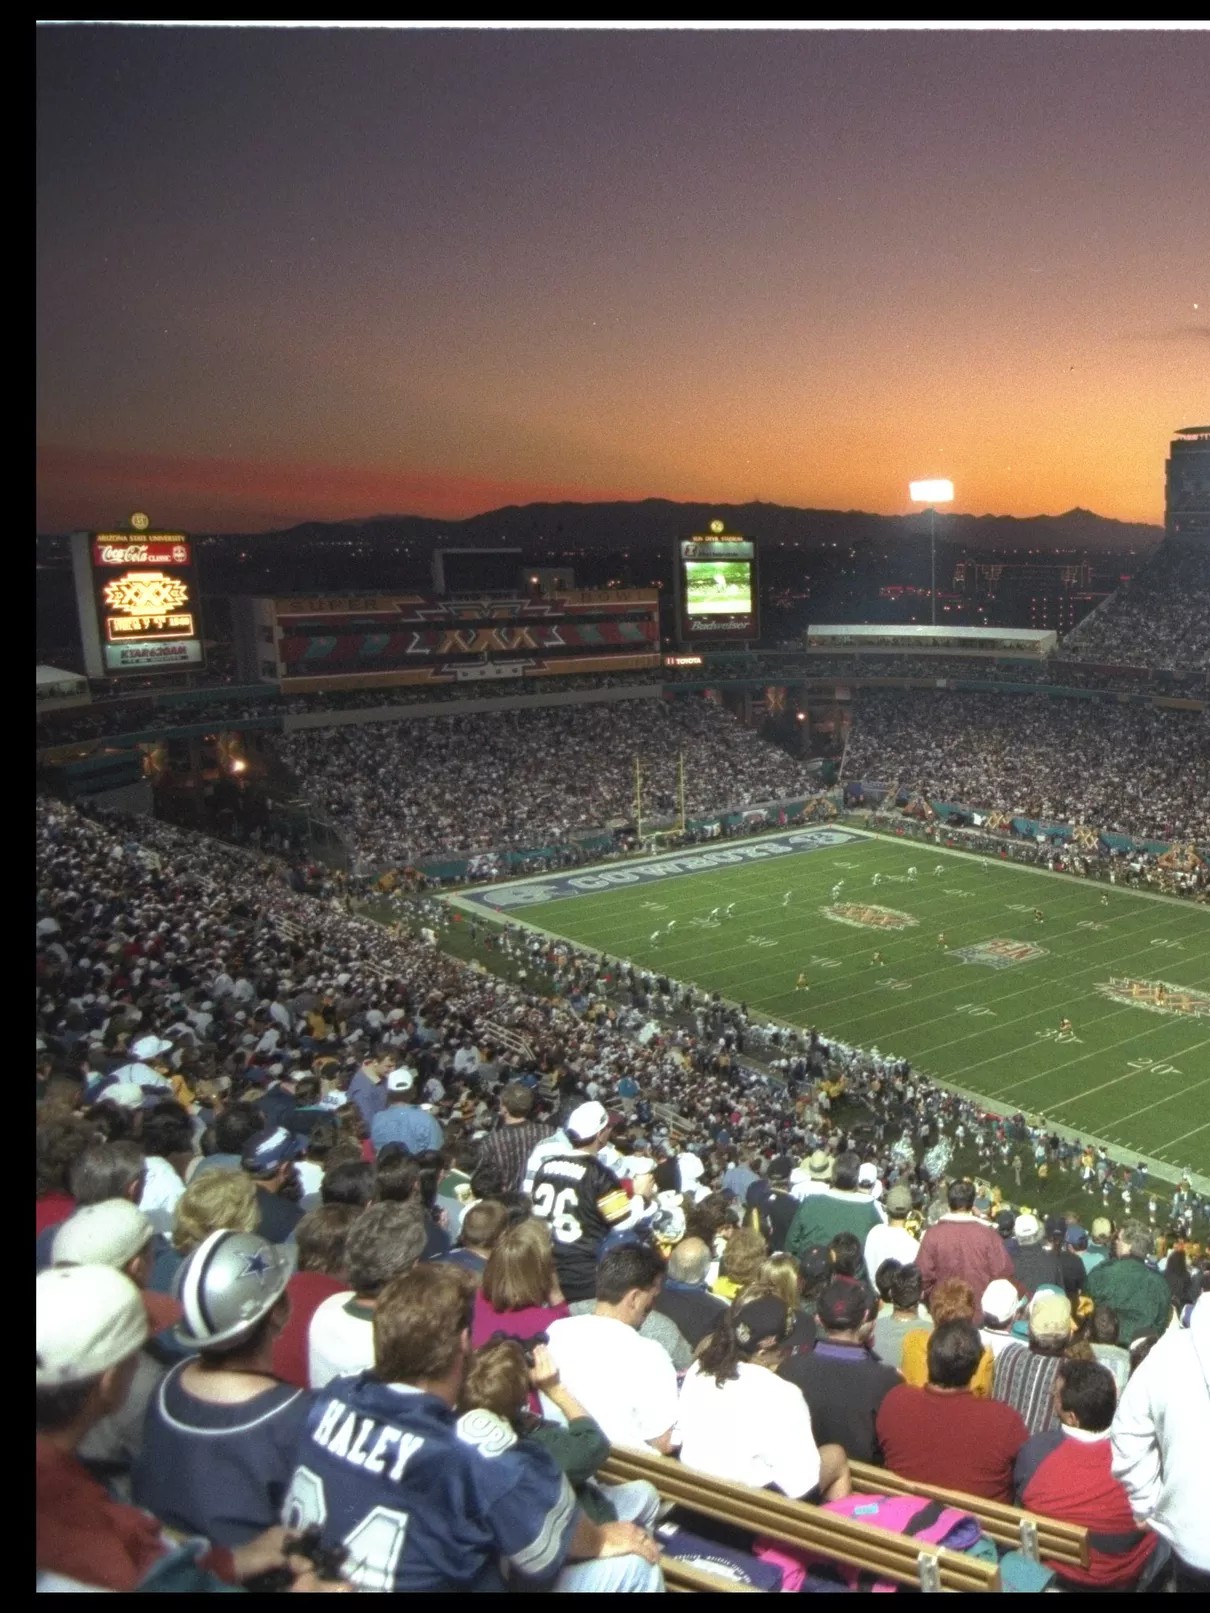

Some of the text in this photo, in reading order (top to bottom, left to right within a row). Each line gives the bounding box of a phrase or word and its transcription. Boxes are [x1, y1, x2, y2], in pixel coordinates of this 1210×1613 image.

[289, 590, 644, 611] SUPER BOWL
[691, 620, 750, 631] Budweiser
[675, 657, 702, 665] TOYOTA
[567, 841, 793, 890] COWBOYS
[531, 1182, 584, 1244] 26
[312, 1399, 426, 1482] HALEY
